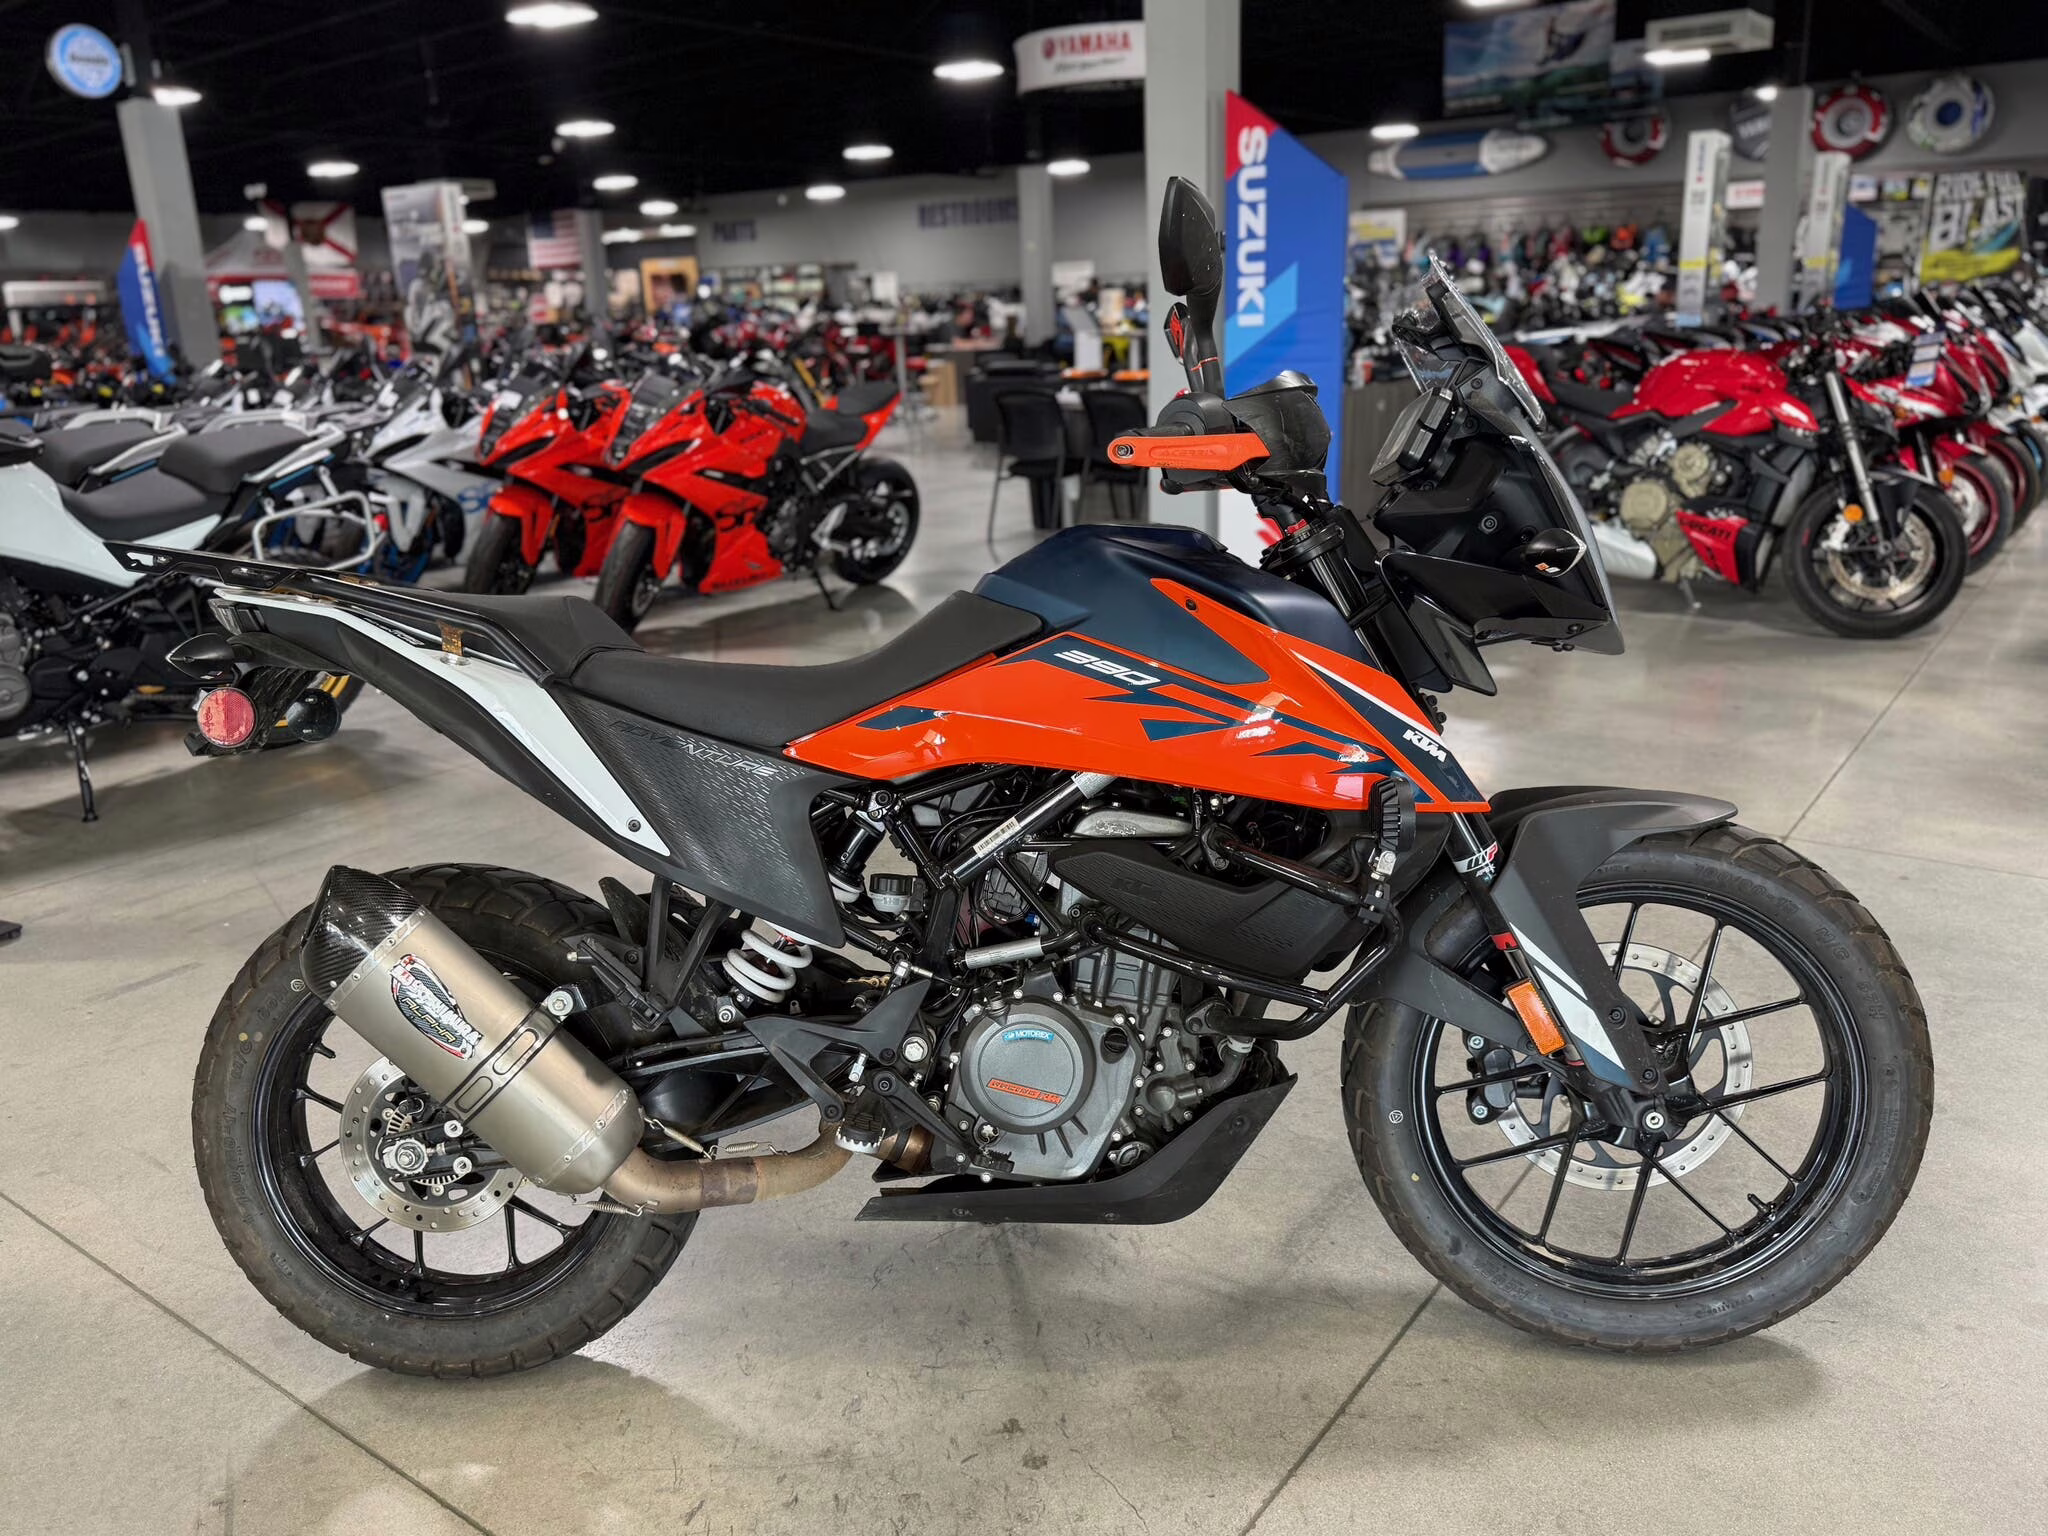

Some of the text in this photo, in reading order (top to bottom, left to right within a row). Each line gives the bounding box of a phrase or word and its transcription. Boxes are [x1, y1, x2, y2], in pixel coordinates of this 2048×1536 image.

[1058, 31, 1133, 56] YAMAHA
[1237, 125, 1268, 327] SUZUKI
[132, 242, 166, 357] SUZUKI
[1053, 650, 1161, 685] 390
[609, 720, 780, 777] ADVENTURE
[1402, 729, 1447, 762] KTM
[402, 997, 457, 1043] ALPHA
[1015, 1030, 1050, 1040] MOTOREX
